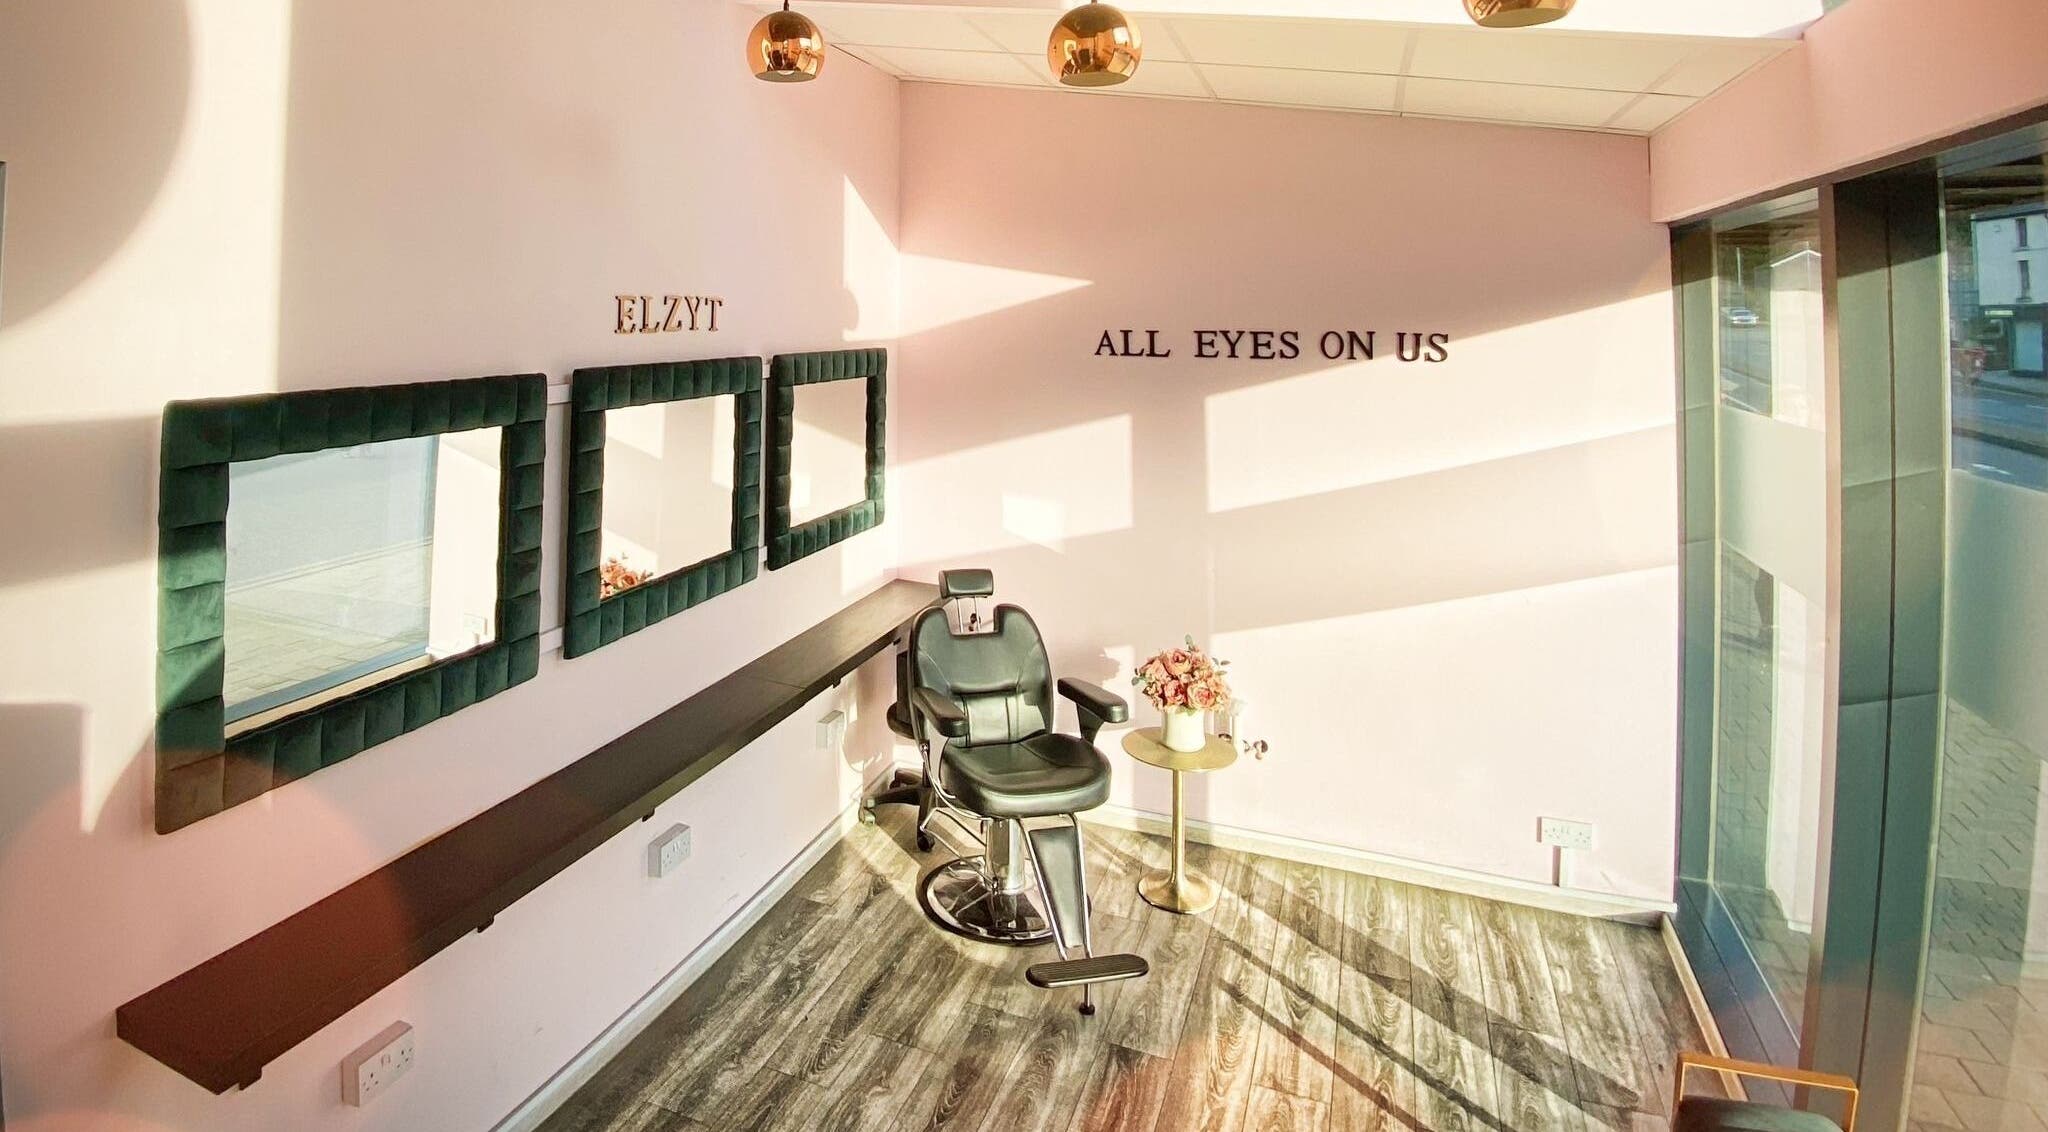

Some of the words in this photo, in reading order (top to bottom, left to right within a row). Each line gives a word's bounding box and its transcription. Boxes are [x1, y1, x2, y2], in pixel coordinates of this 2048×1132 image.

[614, 295, 723, 334] ELZYT
[1094, 329, 1171, 358] ALL
[1193, 330, 1300, 360] EYES
[1320, 330, 1376, 361] ON
[1396, 332, 1449, 363] US
